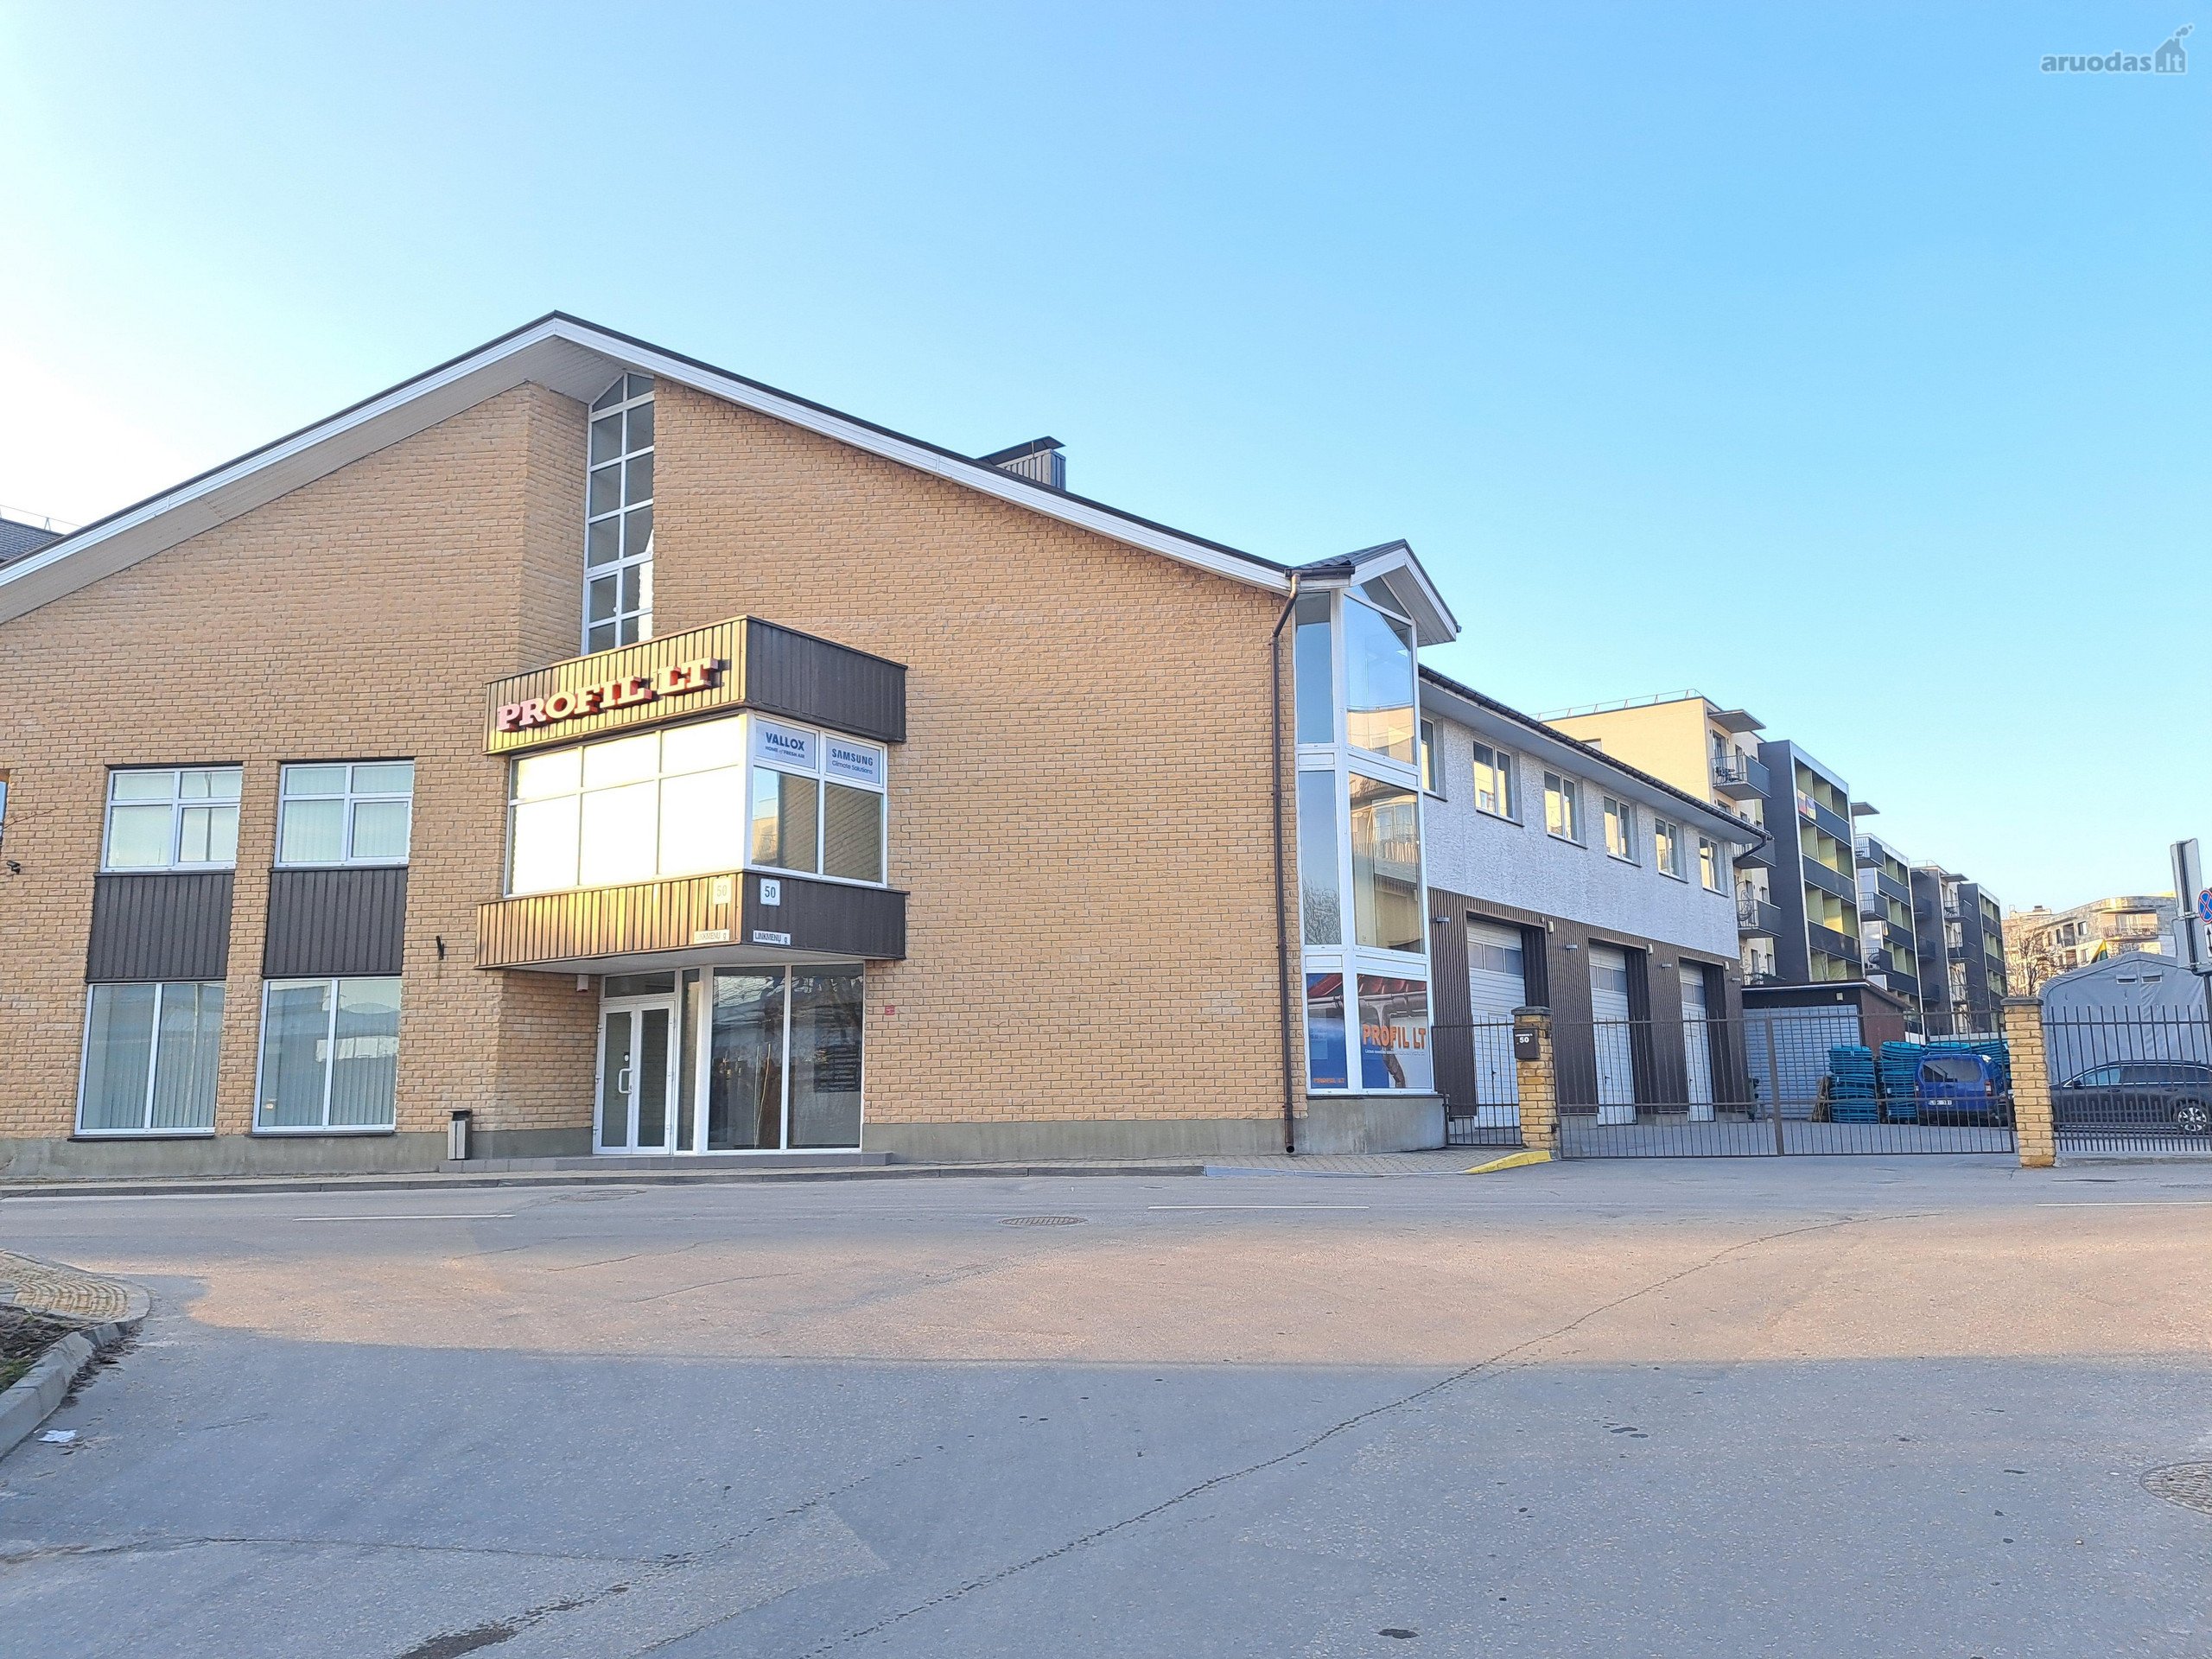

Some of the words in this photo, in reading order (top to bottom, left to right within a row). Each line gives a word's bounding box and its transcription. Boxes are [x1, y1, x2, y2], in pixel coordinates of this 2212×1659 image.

[497, 675, 652, 732] PROFIL
[658, 657, 718, 696] LT
[766, 732, 805, 752] VALLOX
[831, 748, 874, 766] SAMSUNG
[831, 760, 851, 770] Climate
[851, 764, 874, 775] Solutions
[716, 885, 728, 897] 50
[764, 886, 776, 898] 50
[1362, 1022, 1410, 1049] PROFIL
[1412, 1026, 1427, 1050] LT
